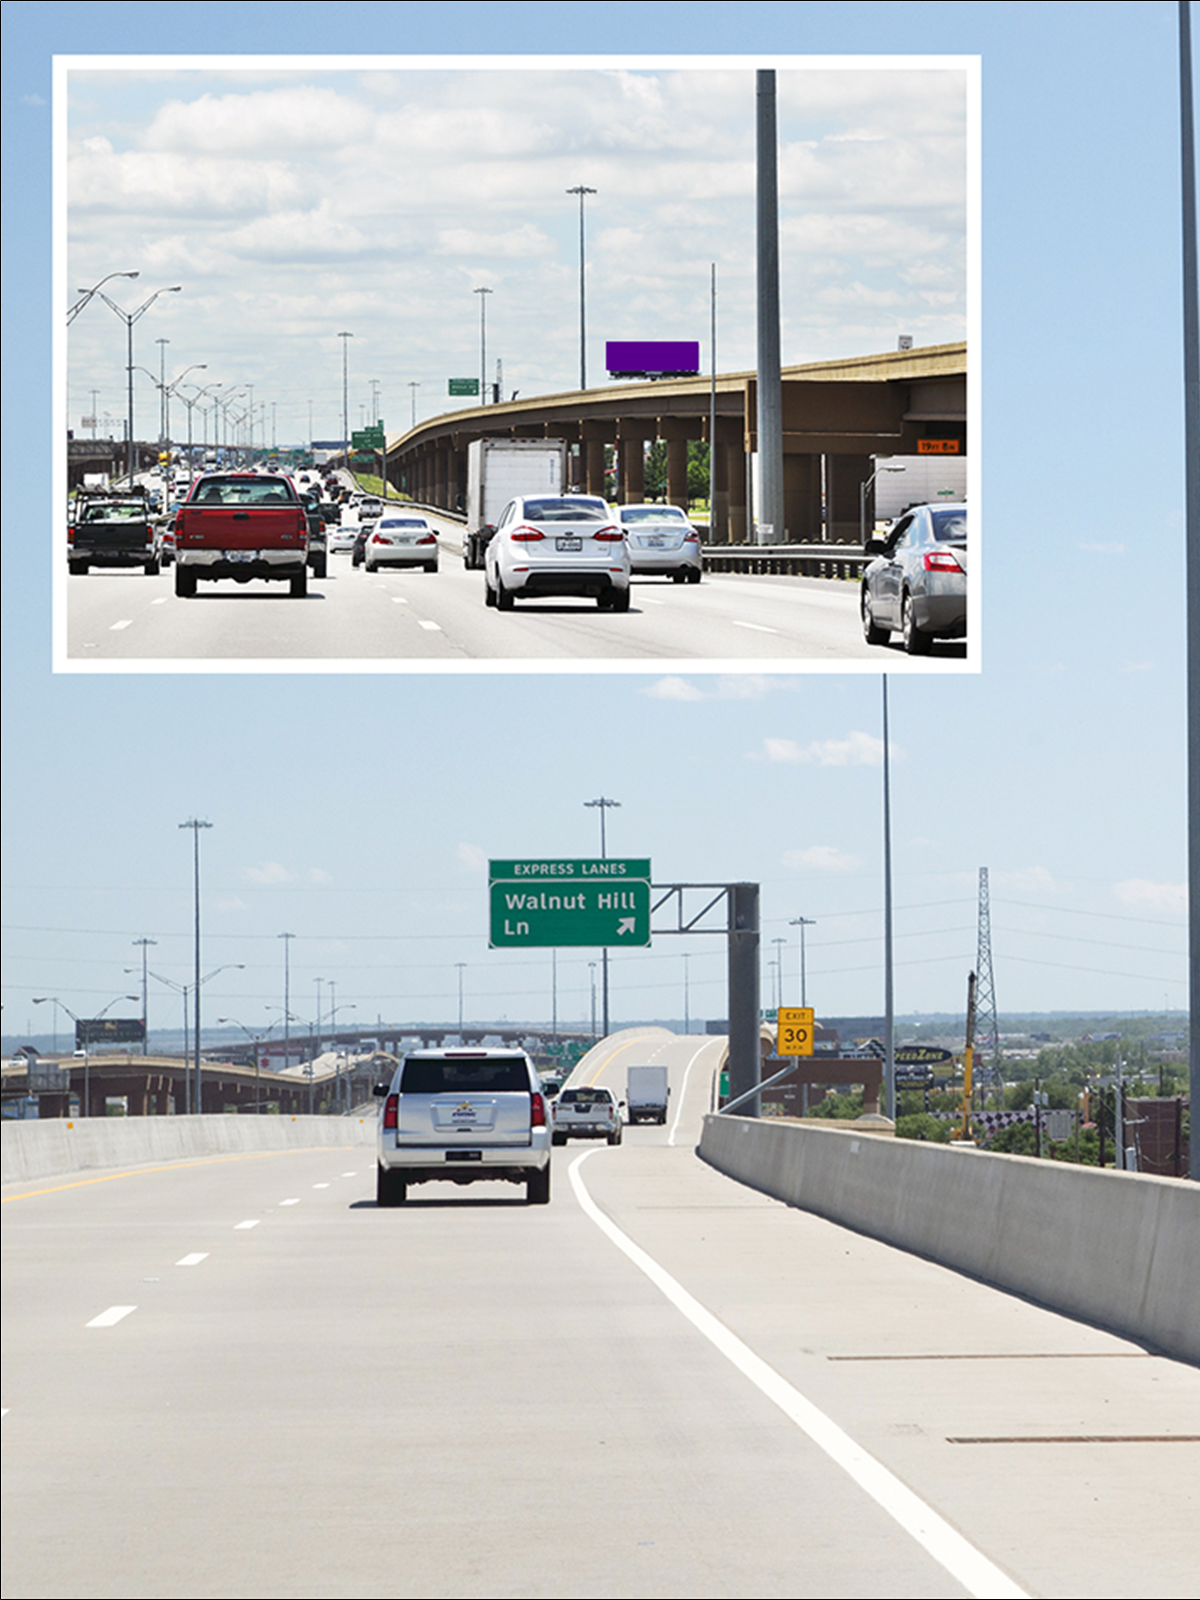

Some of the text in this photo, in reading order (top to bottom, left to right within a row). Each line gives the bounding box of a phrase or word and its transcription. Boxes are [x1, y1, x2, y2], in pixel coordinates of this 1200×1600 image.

[514, 863, 627, 875] EXPRESS LANES
[505, 892, 636, 910] Walnut Hill
[504, 919, 530, 936] Ln
[786, 1011, 806, 1020] EXIT
[784, 1028, 808, 1043] 30
